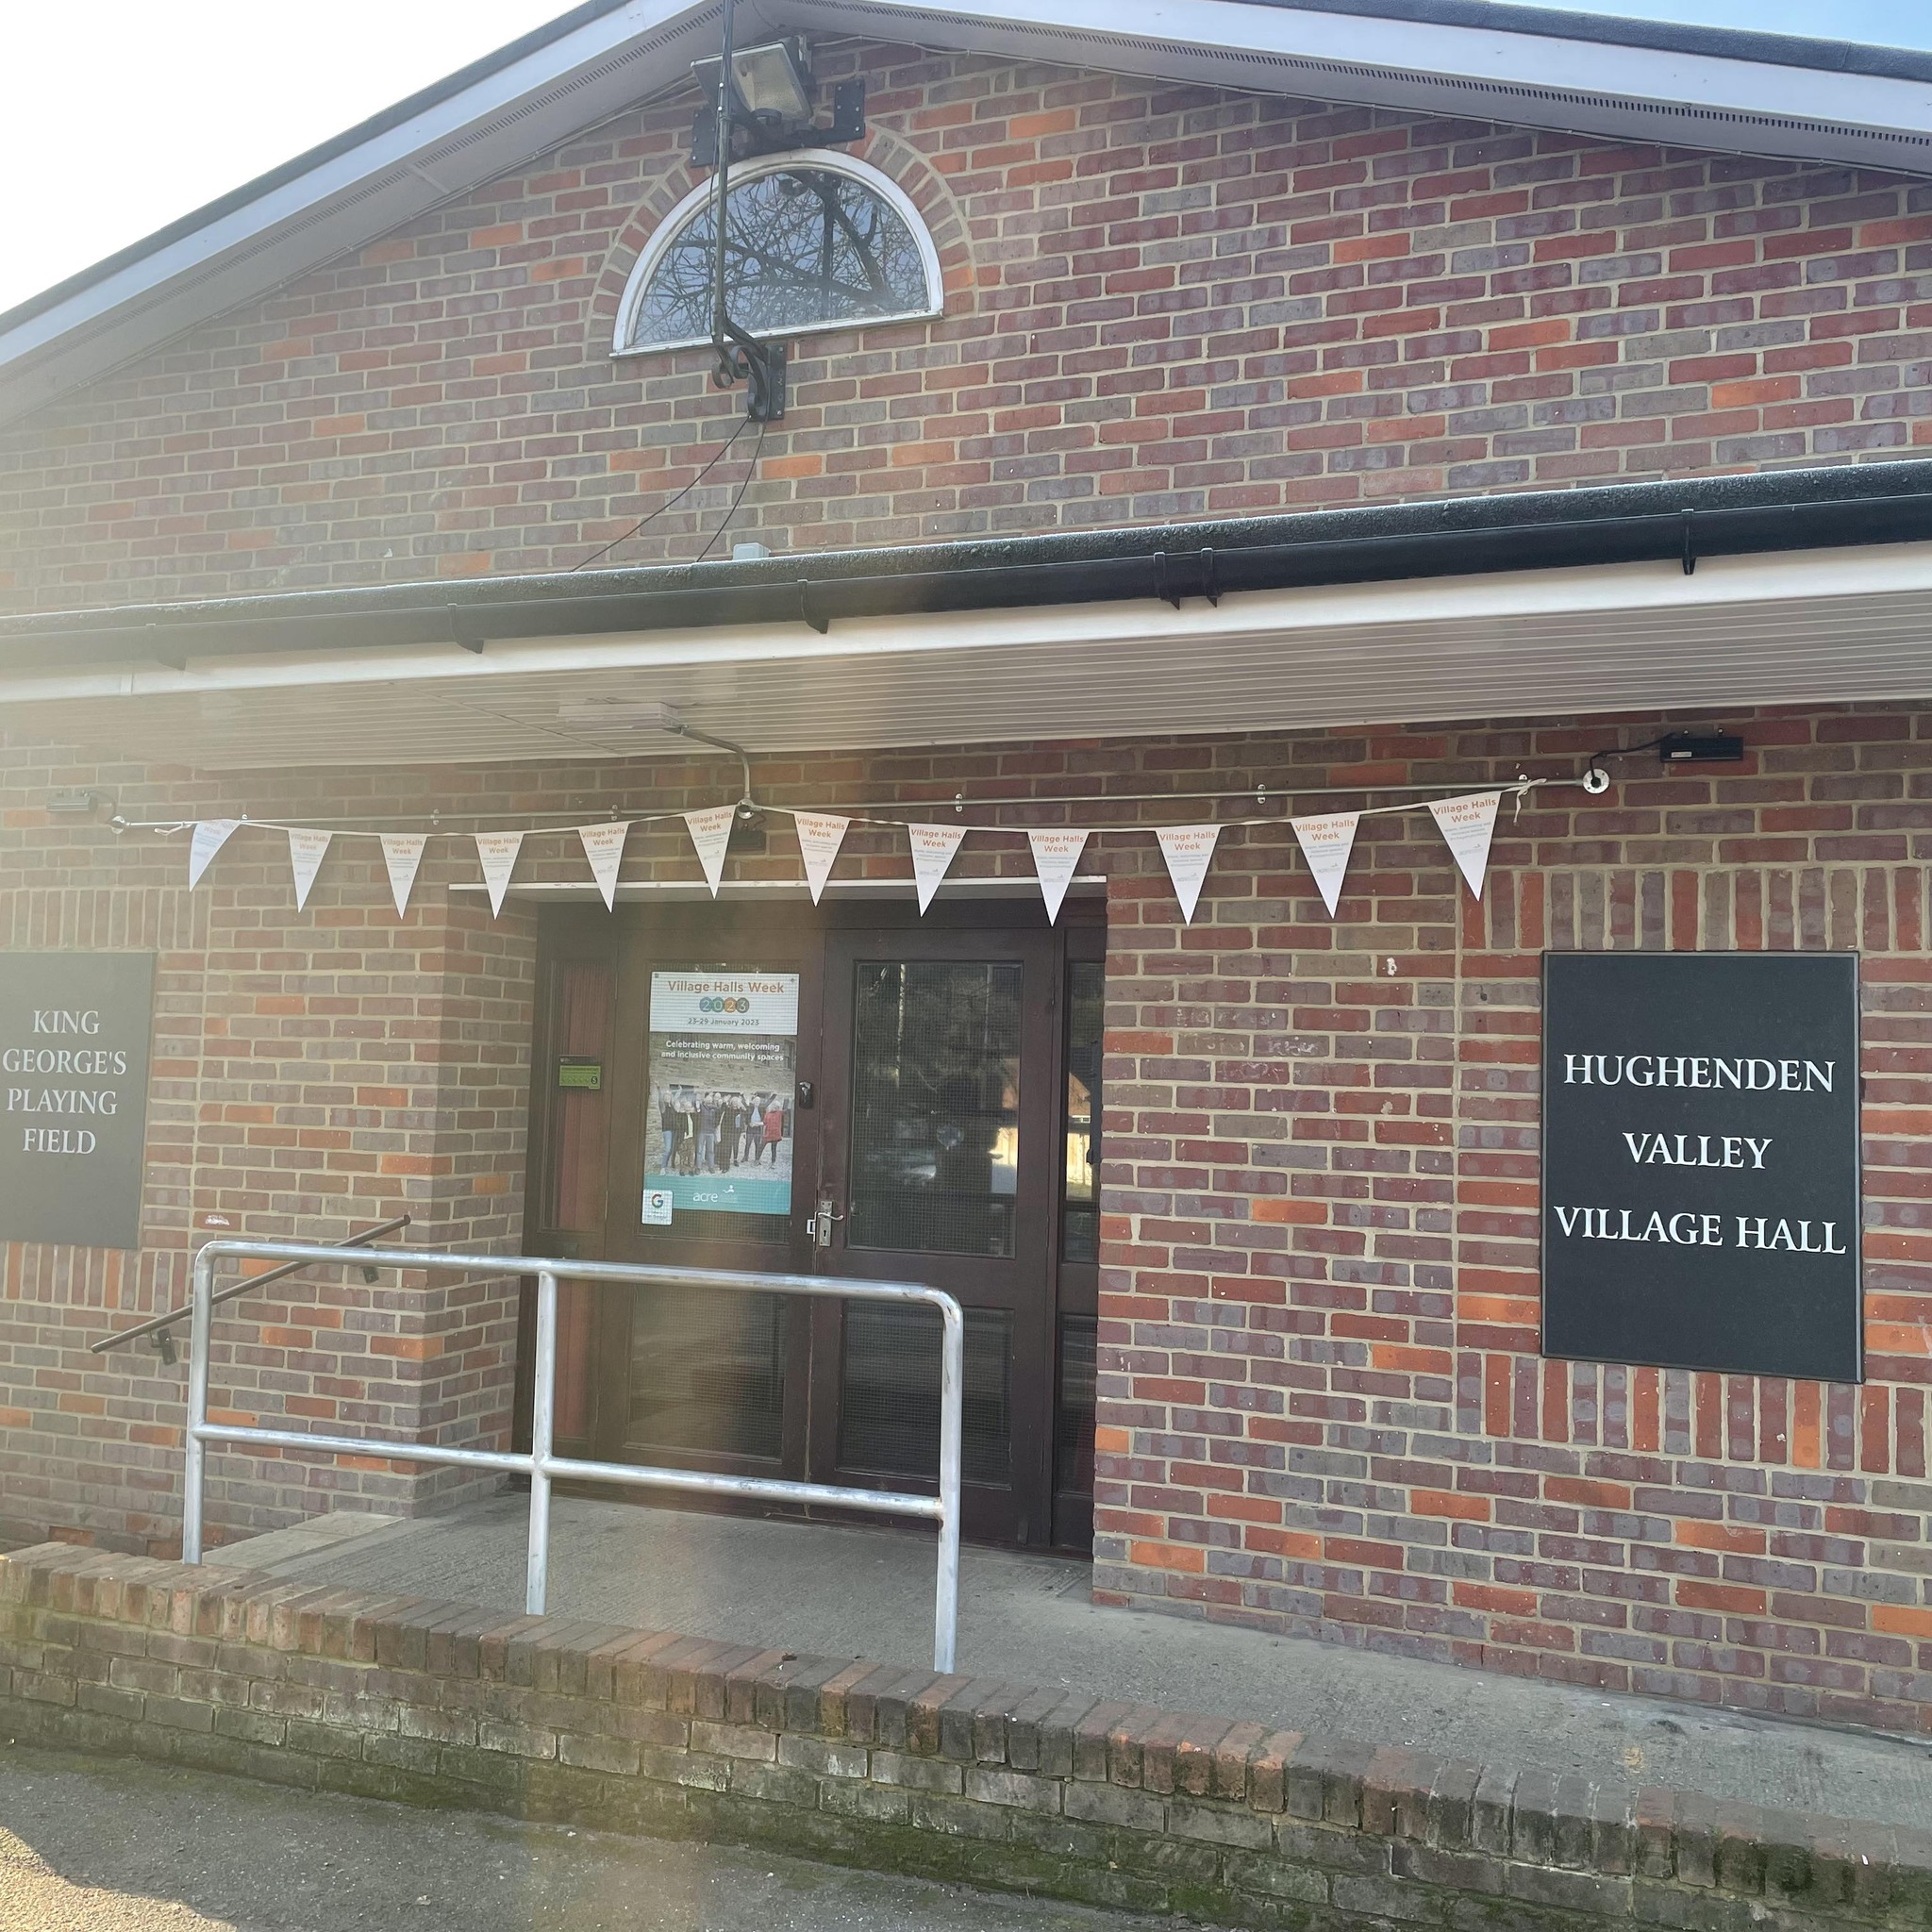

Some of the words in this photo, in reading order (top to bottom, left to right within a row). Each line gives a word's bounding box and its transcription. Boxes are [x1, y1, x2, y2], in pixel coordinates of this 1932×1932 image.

[1433, 804, 1469, 815] Village
[1471, 798, 1497, 809] Halls
[687, 816, 713, 825] Village
[714, 812, 732, 821] Halls
[1451, 811, 1481, 824] Week
[700, 823, 722, 832] Week
[796, 818, 824, 829] Village
[824, 821, 845, 830] Halls
[1294, 823, 1328, 832] Village
[1331, 820, 1355, 828] Halls
[581, 829, 606, 839] Village
[608, 827, 625, 836] Halls
[808, 829, 832, 839] Week
[910, 828, 940, 840] Village
[941, 830, 961, 840] Halls
[1031, 834, 1060, 843] Village
[1062, 835, 1084, 843] Halls
[1159, 833, 1191, 842] Village
[1193, 831, 1216, 840] Halls
[1311, 832, 1340, 841] Week
[592, 838, 613, 846] Week
[923, 839, 946, 848] Week
[1174, 842, 1201, 851] Week
[1043, 844, 1069, 853] Week
[668, 981, 709, 993] Village
[714, 981, 743, 992] Halls
[748, 982, 784, 993] Week
[702, 998, 747, 1012] 2023
[32, 1010, 100, 1035] KING
[665, 1040, 710, 1050] Celebrating
[712, 1042, 736, 1051] warm,
[738, 1042, 780, 1052] welcoming
[2, 1048, 127, 1074] GEORGE'S
[677, 1051, 711, 1059] inclusive
[712, 1052, 755, 1061] community
[757, 1054, 784, 1063] spaces
[1563, 1054, 1836, 1093] HUGHENDEN
[6, 1088, 118, 1115] PLAYING
[23, 1127, 96, 1155] FIELD
[1623, 1132, 1774, 1170] VALLEY
[692, 1192, 719, 1203] acre
[1554, 1206, 1724, 1248] VILLAGE
[1735, 1216, 1847, 1256] HALL
